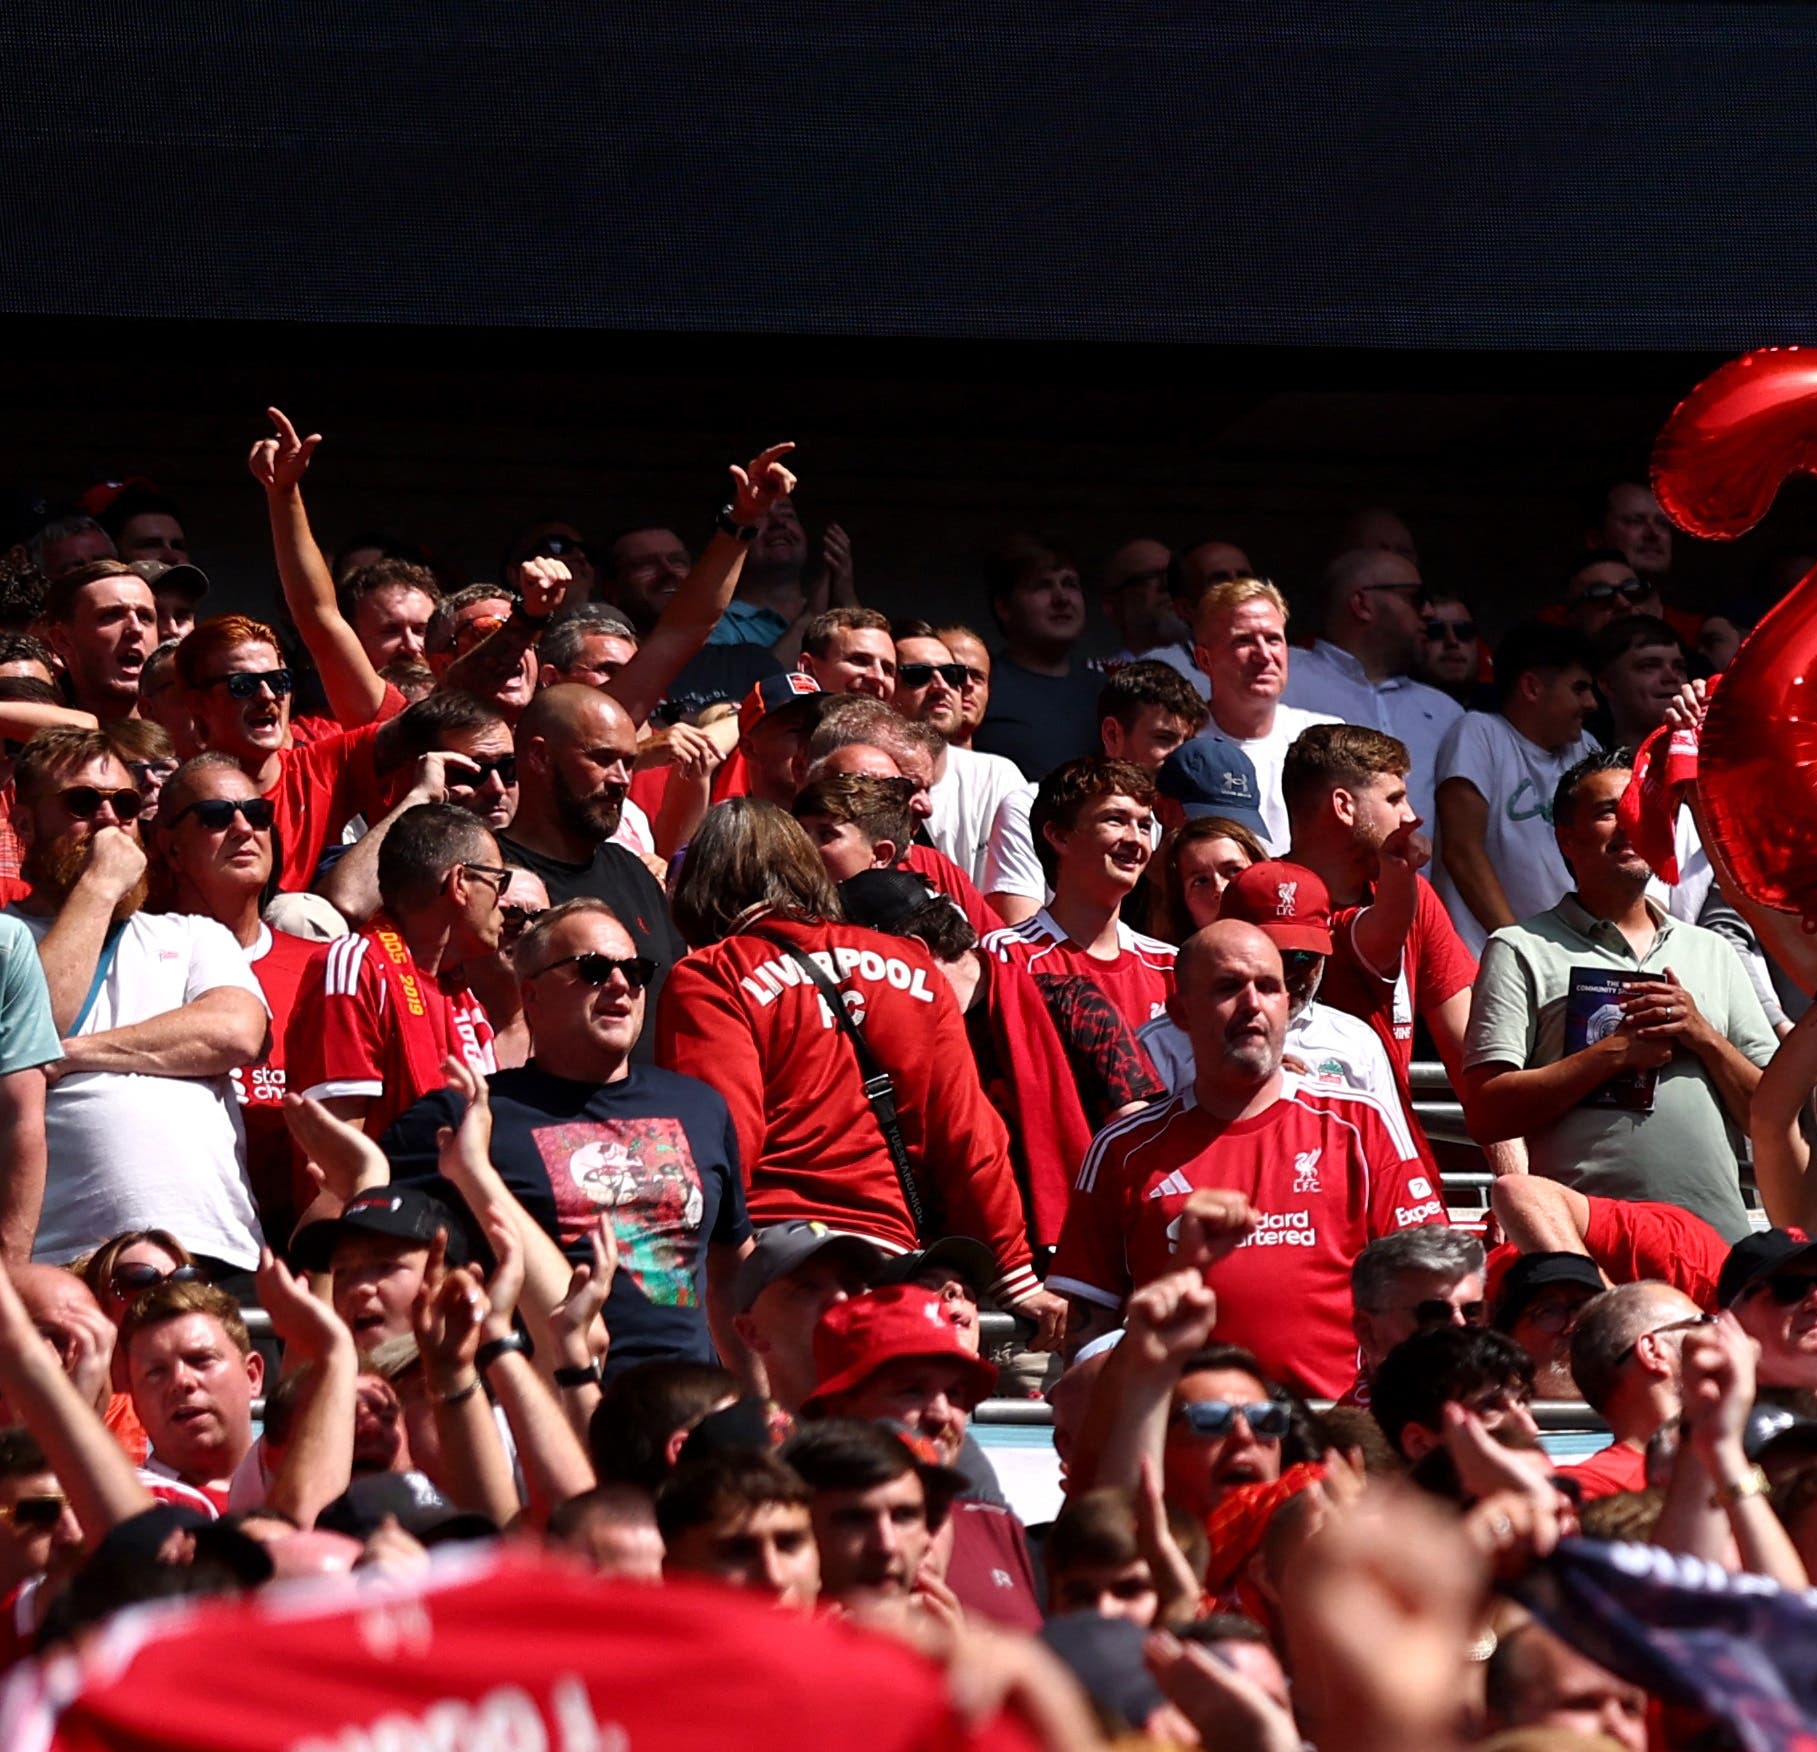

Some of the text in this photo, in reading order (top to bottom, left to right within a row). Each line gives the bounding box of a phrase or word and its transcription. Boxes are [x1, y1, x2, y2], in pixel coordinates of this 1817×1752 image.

[399, 972, 425, 1017] 2019
[1576, 984, 1617, 994] COMMUNITY
[1236, 1228, 1316, 1248] rtered
